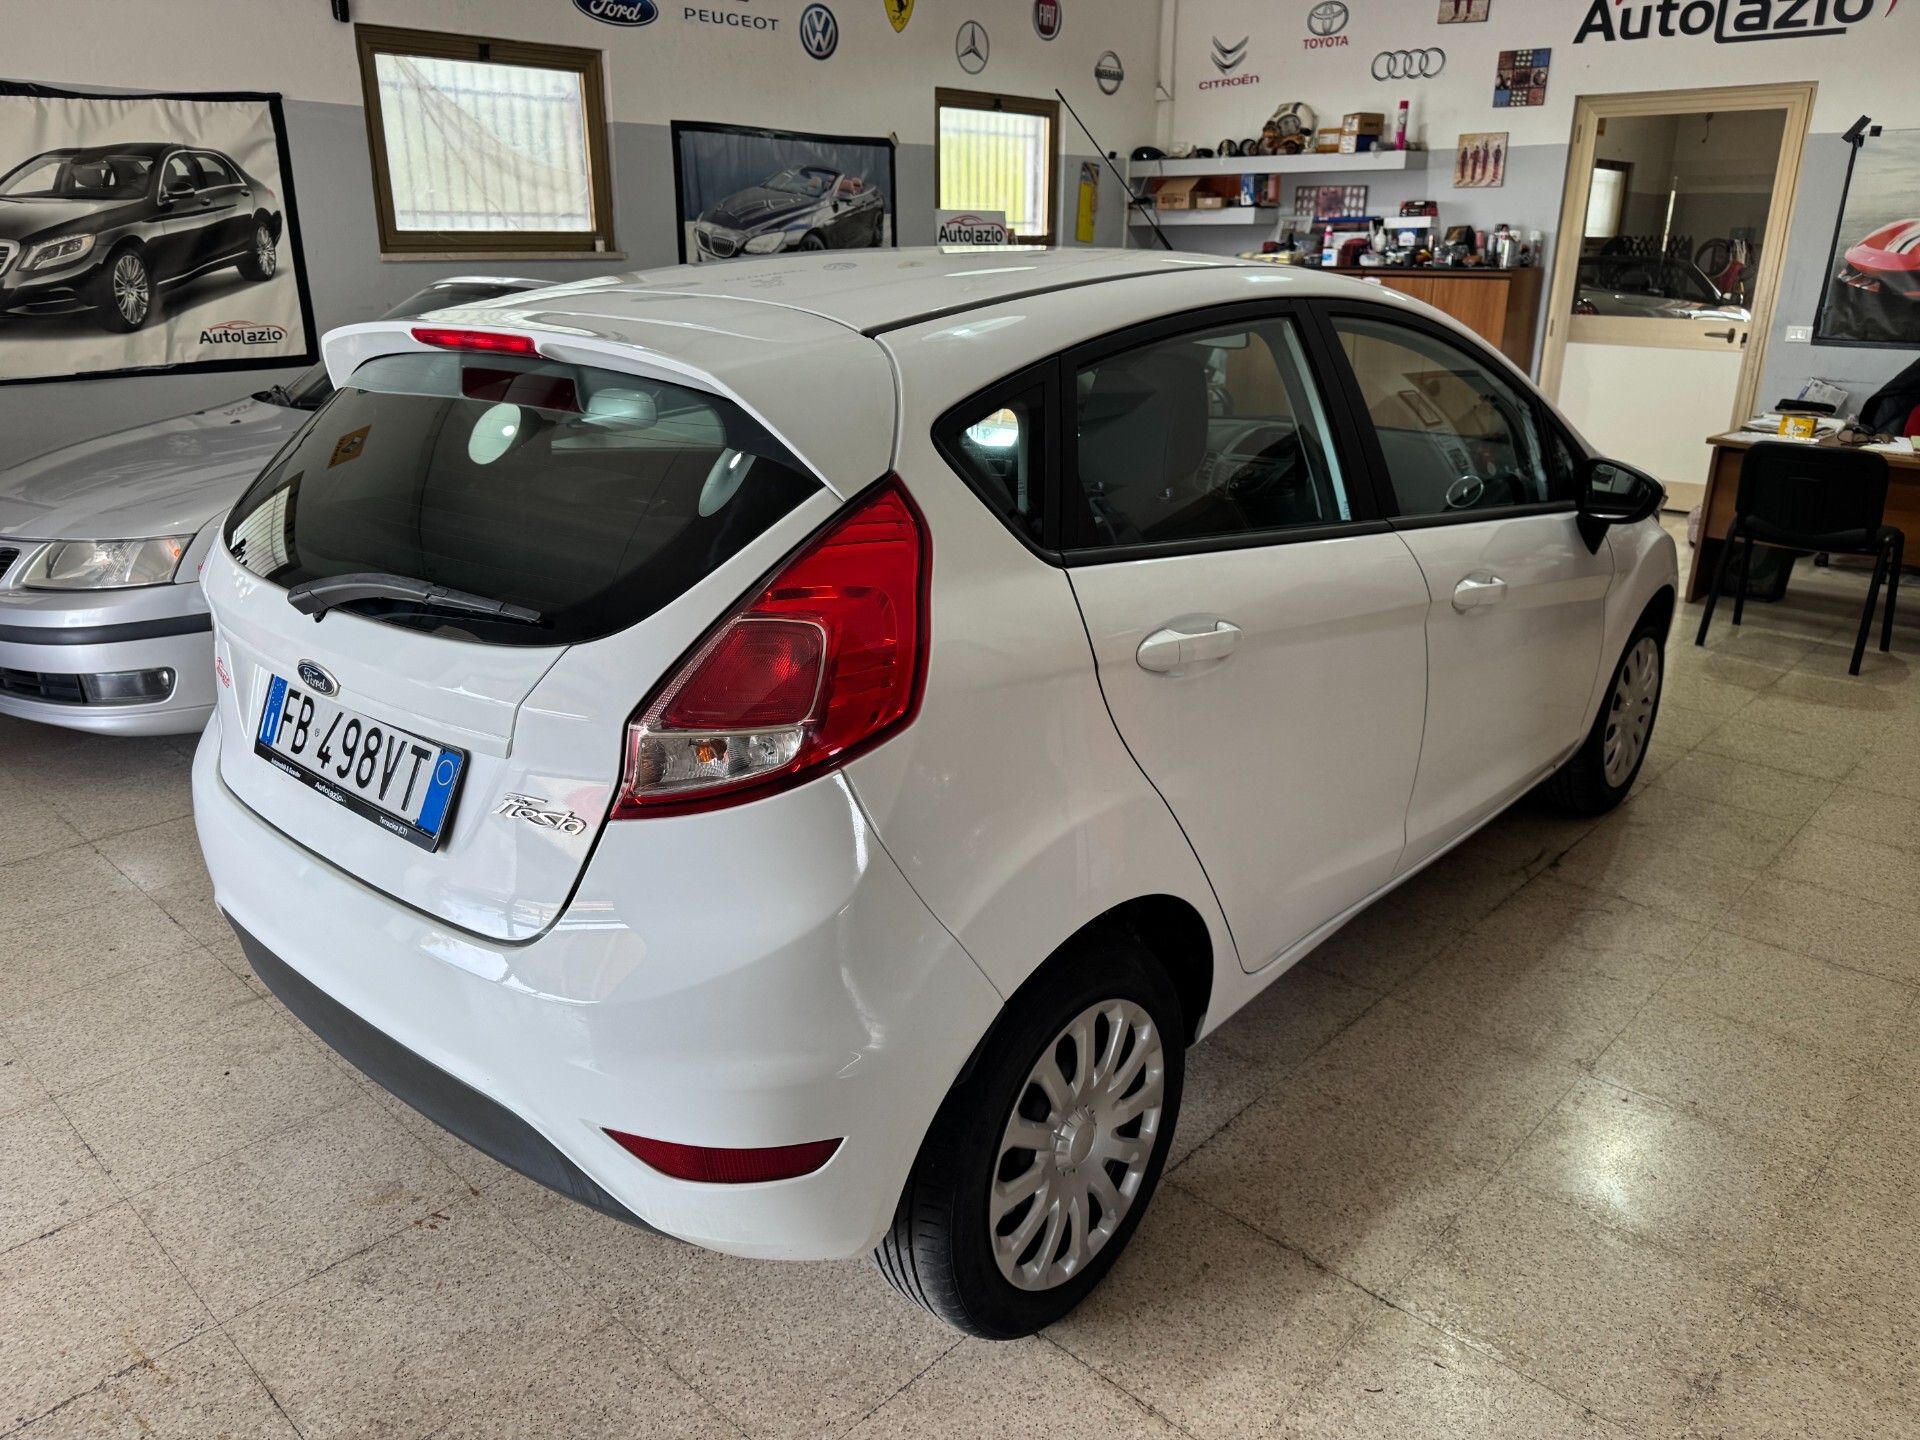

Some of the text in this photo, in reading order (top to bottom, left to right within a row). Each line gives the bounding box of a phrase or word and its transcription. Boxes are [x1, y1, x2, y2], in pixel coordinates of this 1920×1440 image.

[684, 7, 779, 31] PEUGEOT
[1037, 3, 1056, 28] FIAT
[1303, 35, 1349, 50] TOYOTA
[199, 328, 283, 345] AutoLazio
[303, 667, 327, 691] Ford
[276, 688, 432, 812] FB 498VT
[492, 792, 587, 836] Fiesta
